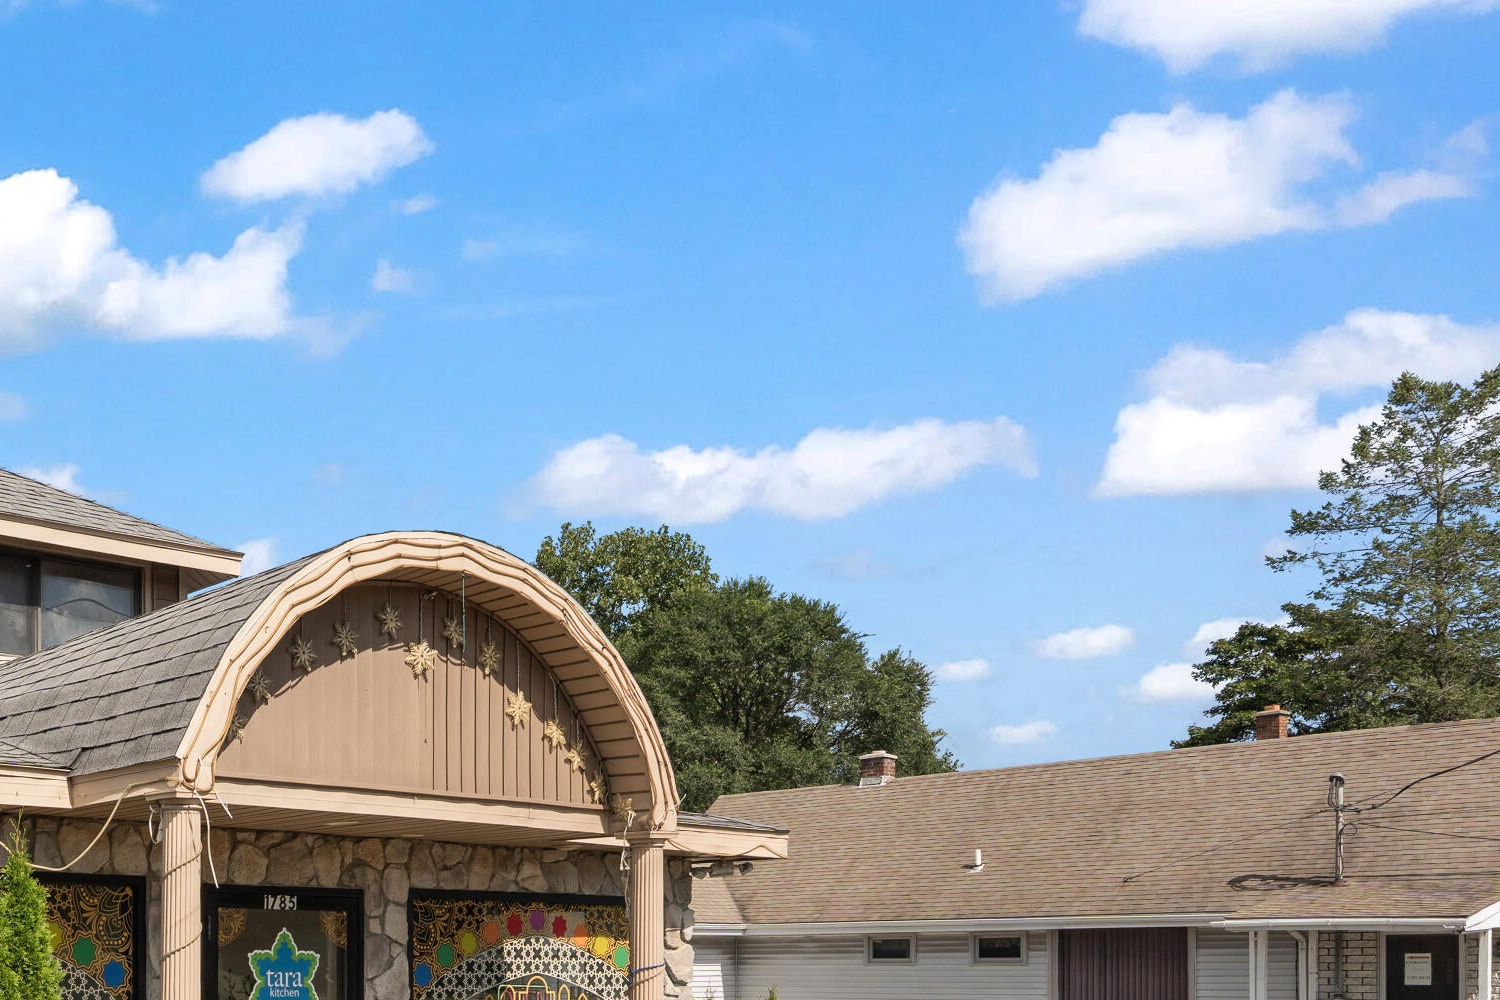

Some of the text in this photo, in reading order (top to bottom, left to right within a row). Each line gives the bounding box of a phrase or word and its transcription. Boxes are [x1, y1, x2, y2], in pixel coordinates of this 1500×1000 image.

[263, 895, 297, 910] 1785
[266, 969, 304, 988] tara
[269, 988, 300, 997] kitchen
